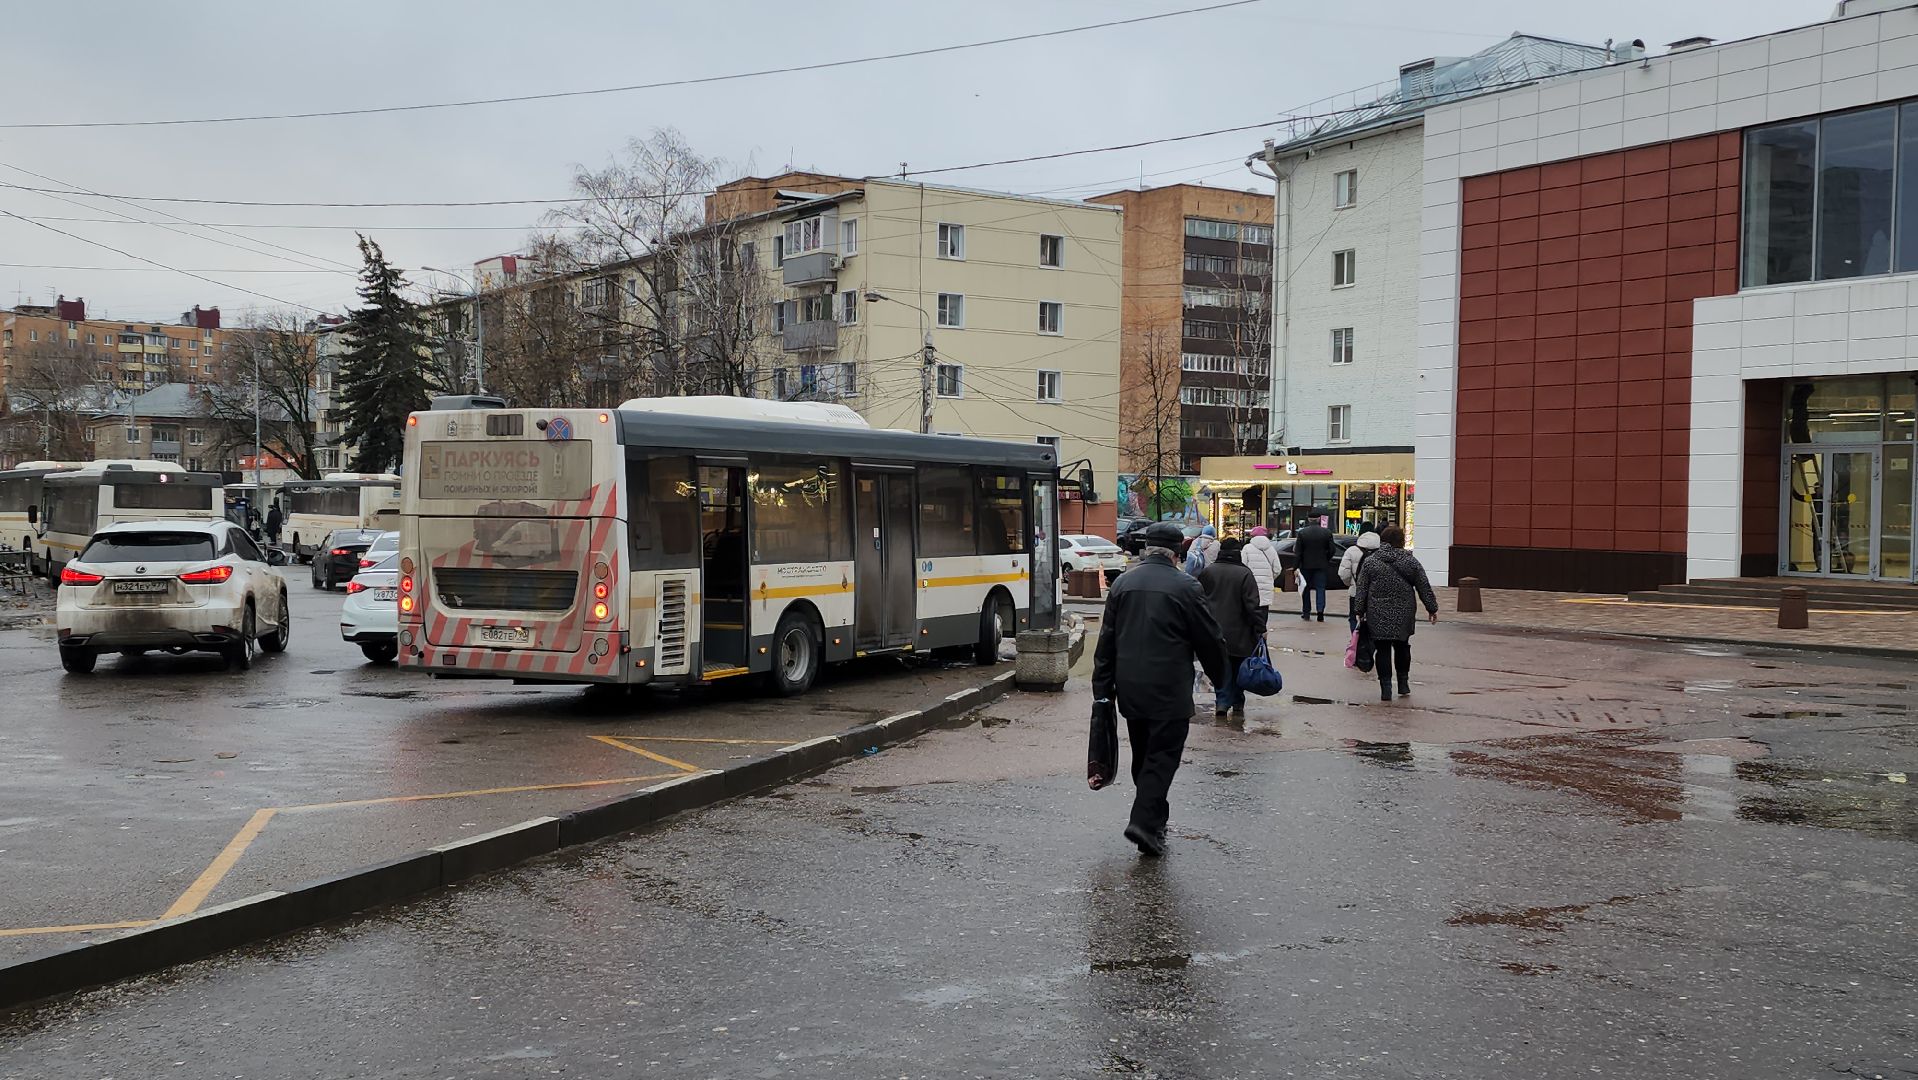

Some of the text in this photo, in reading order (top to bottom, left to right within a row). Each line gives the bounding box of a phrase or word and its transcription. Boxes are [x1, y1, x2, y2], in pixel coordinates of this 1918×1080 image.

[445, 450, 540, 468] ПАРКУЯСЬ
[160, 474, 168, 483] 9
[444, 470, 539, 482] ПОМНИ О ПРОЕЗДЕ
[443, 482, 538, 494] ПОЖАРНЫХ И СКОРОЙ!
